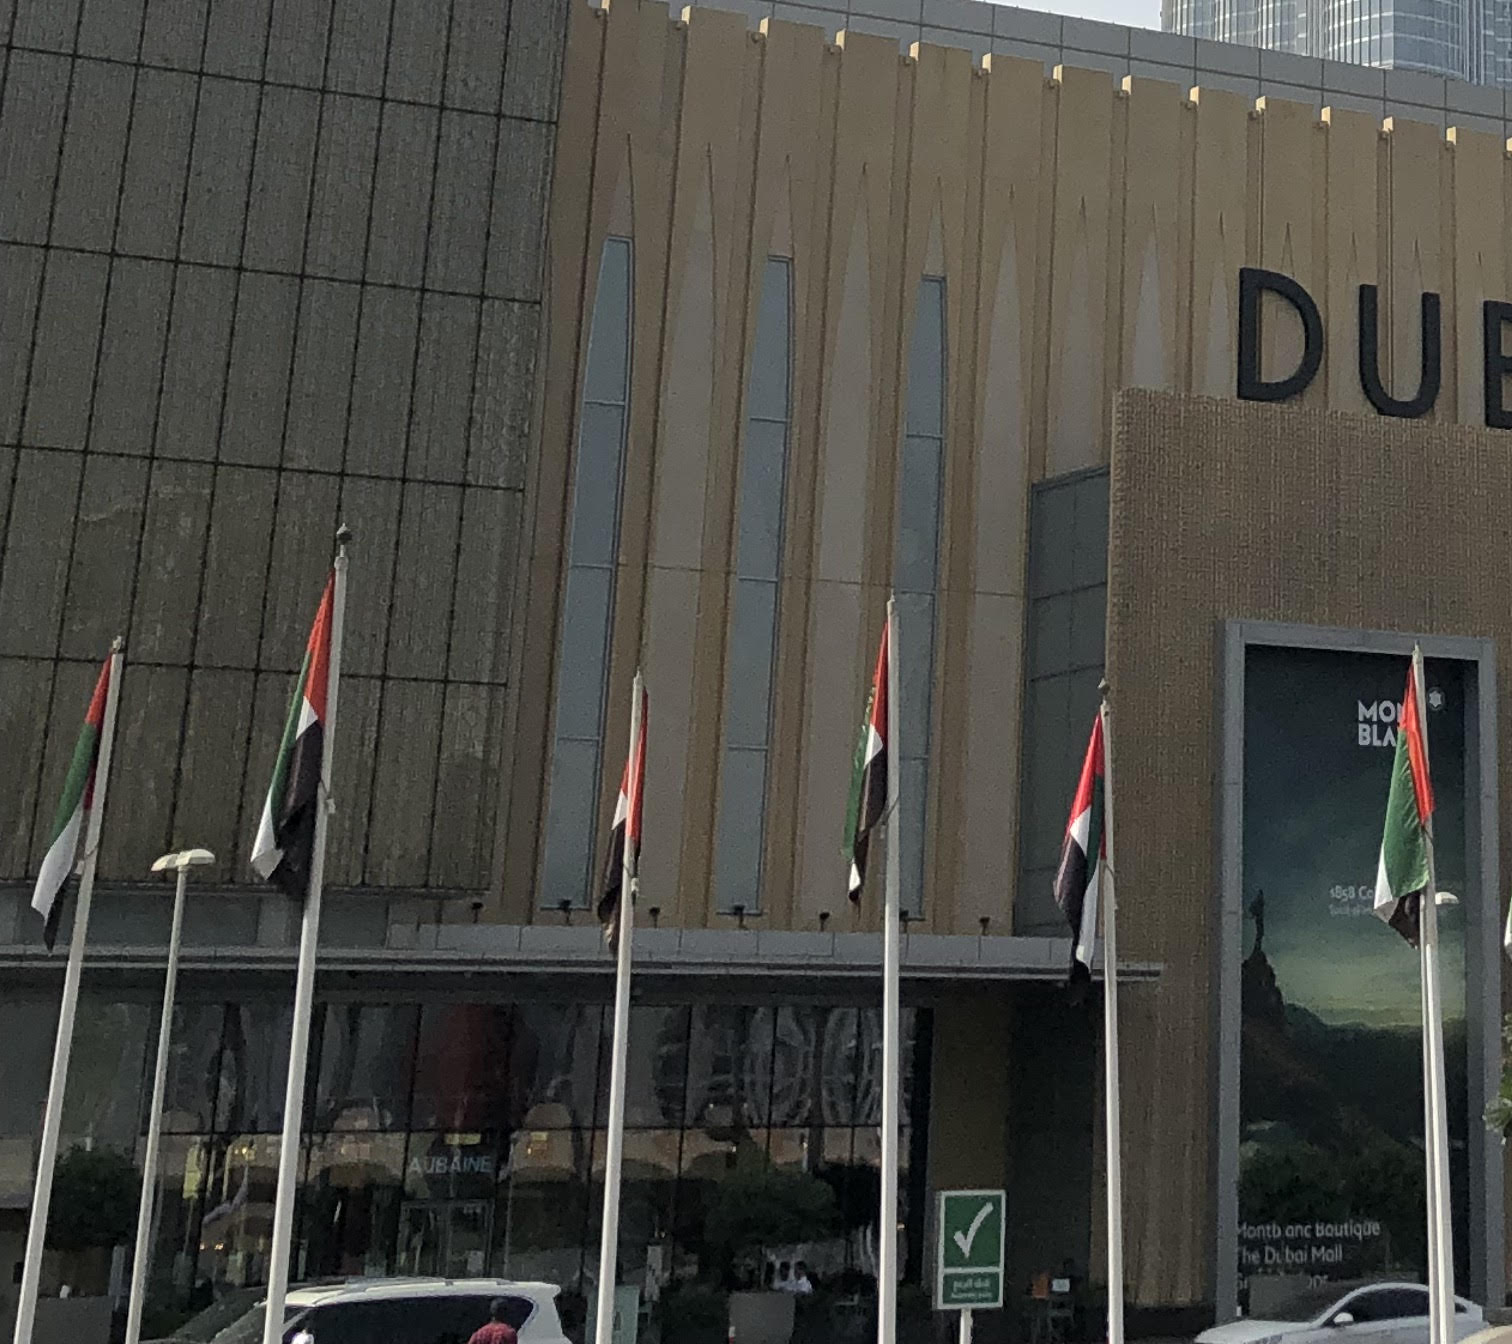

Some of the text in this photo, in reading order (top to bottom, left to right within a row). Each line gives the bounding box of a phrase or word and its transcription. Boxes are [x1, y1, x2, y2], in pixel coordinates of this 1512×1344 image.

[1358, 700, 1403, 723] MO
[1358, 723, 1397, 747] BLA
[408, 1155, 492, 1174] AUBAINE
